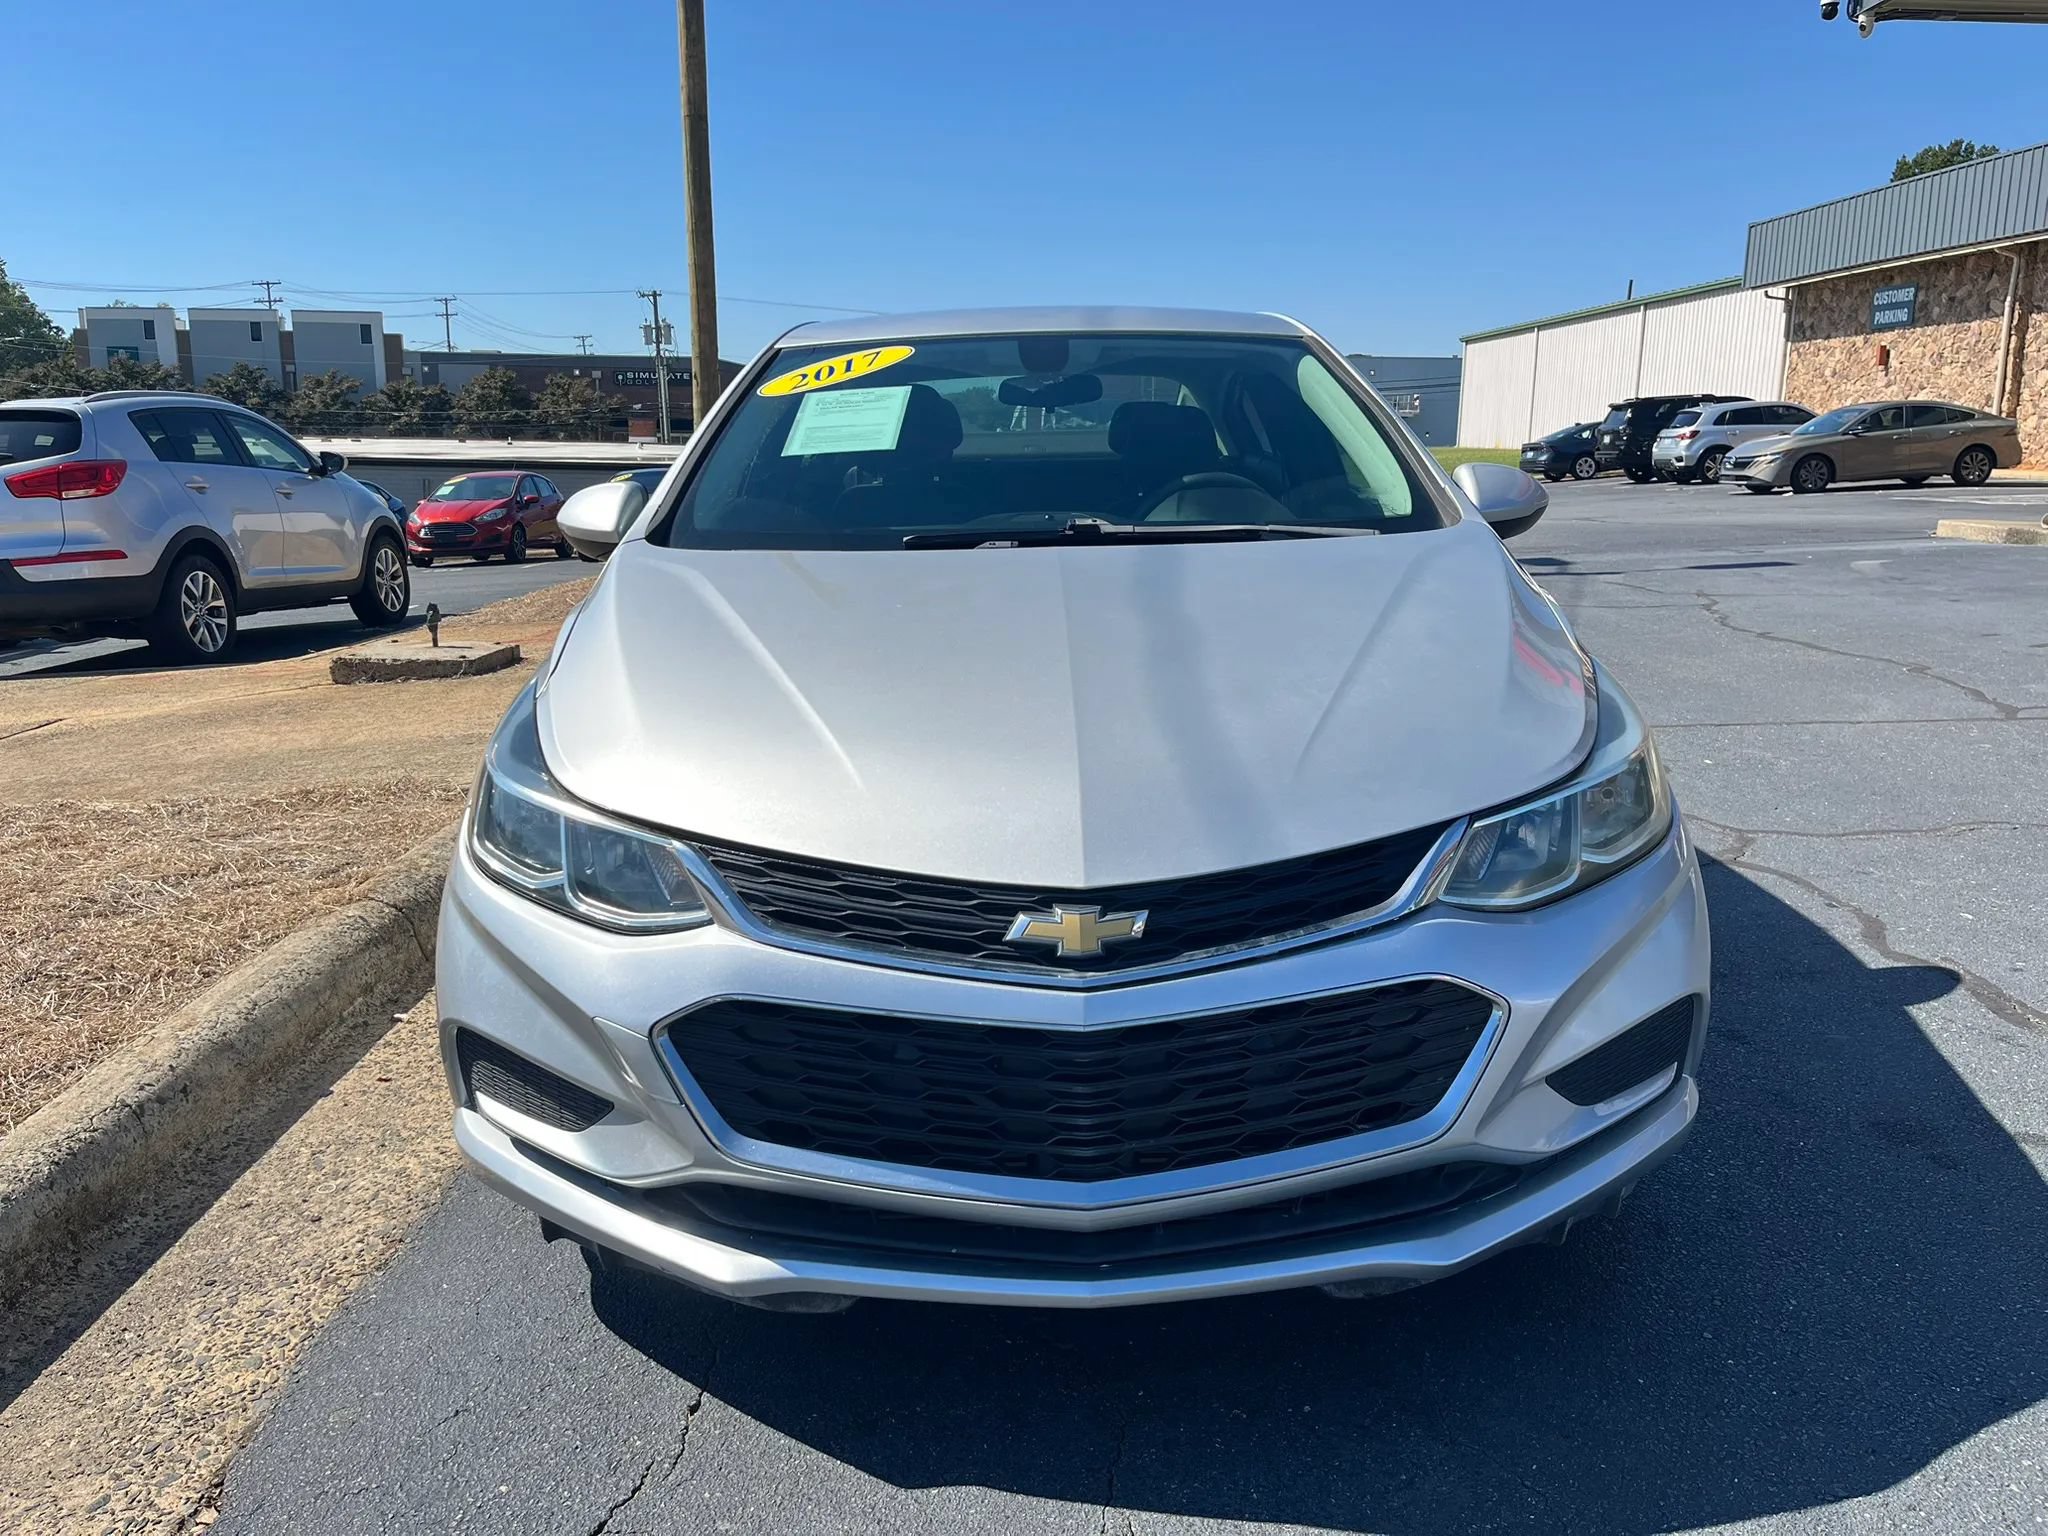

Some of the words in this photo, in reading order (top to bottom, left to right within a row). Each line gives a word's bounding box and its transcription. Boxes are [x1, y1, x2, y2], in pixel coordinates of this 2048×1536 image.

[1873, 287, 1915, 305] CUSTOMER
[1874, 308, 1908, 325] PARKING
[626, 371, 690, 380] SIMUATE
[788, 350, 882, 391] 2017
